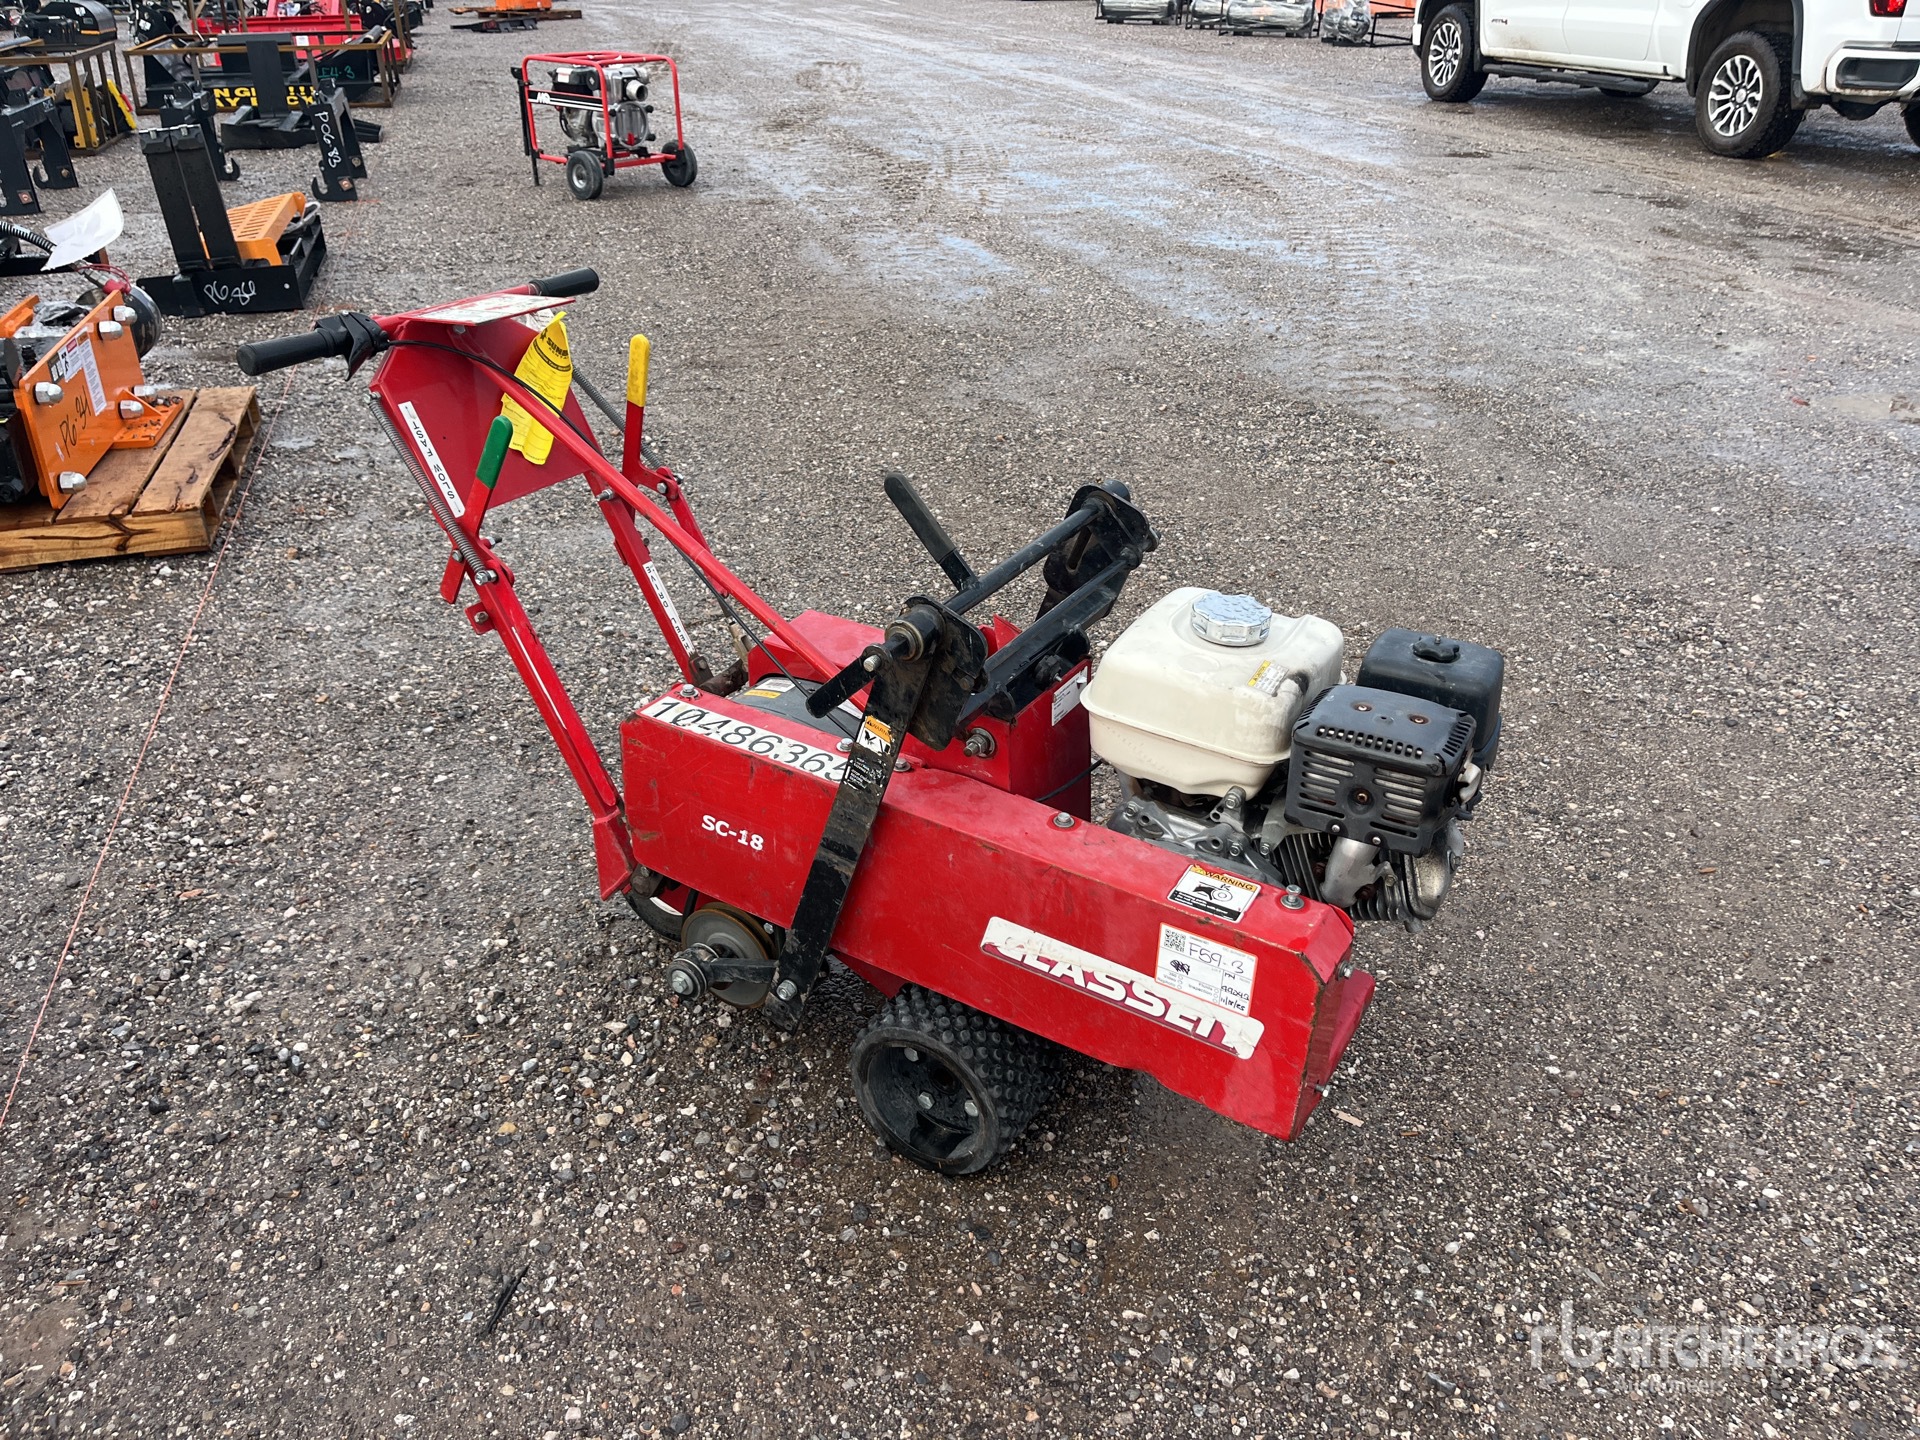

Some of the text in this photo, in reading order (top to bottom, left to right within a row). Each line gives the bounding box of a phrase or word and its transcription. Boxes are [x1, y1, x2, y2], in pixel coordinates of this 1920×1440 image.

[412, 421, 455, 499] SLOW FAST
[701, 814, 764, 851] SC-18
[1205, 871, 1254, 891] WARNING
